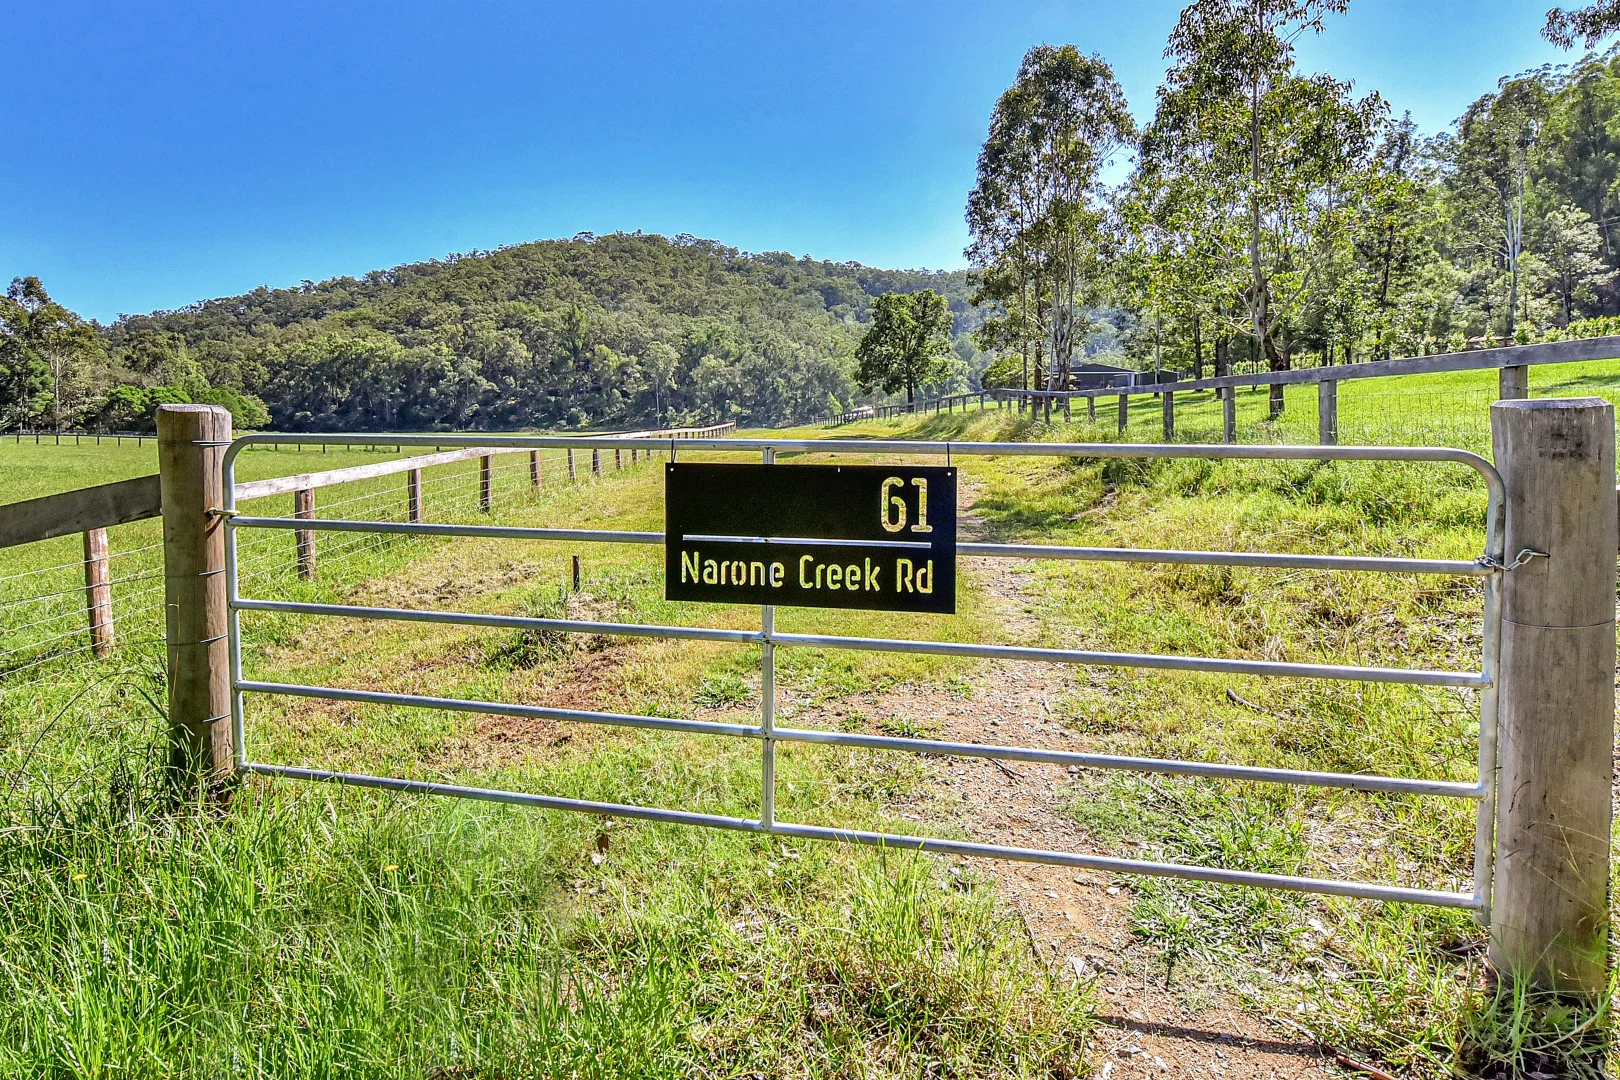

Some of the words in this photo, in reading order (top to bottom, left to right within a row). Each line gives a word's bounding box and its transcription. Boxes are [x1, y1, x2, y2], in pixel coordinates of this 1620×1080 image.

[880, 476, 934, 533] 61
[681, 550, 785, 588] Narone
[799, 554, 881, 592] Creek
[896, 558, 933, 594] Rd
